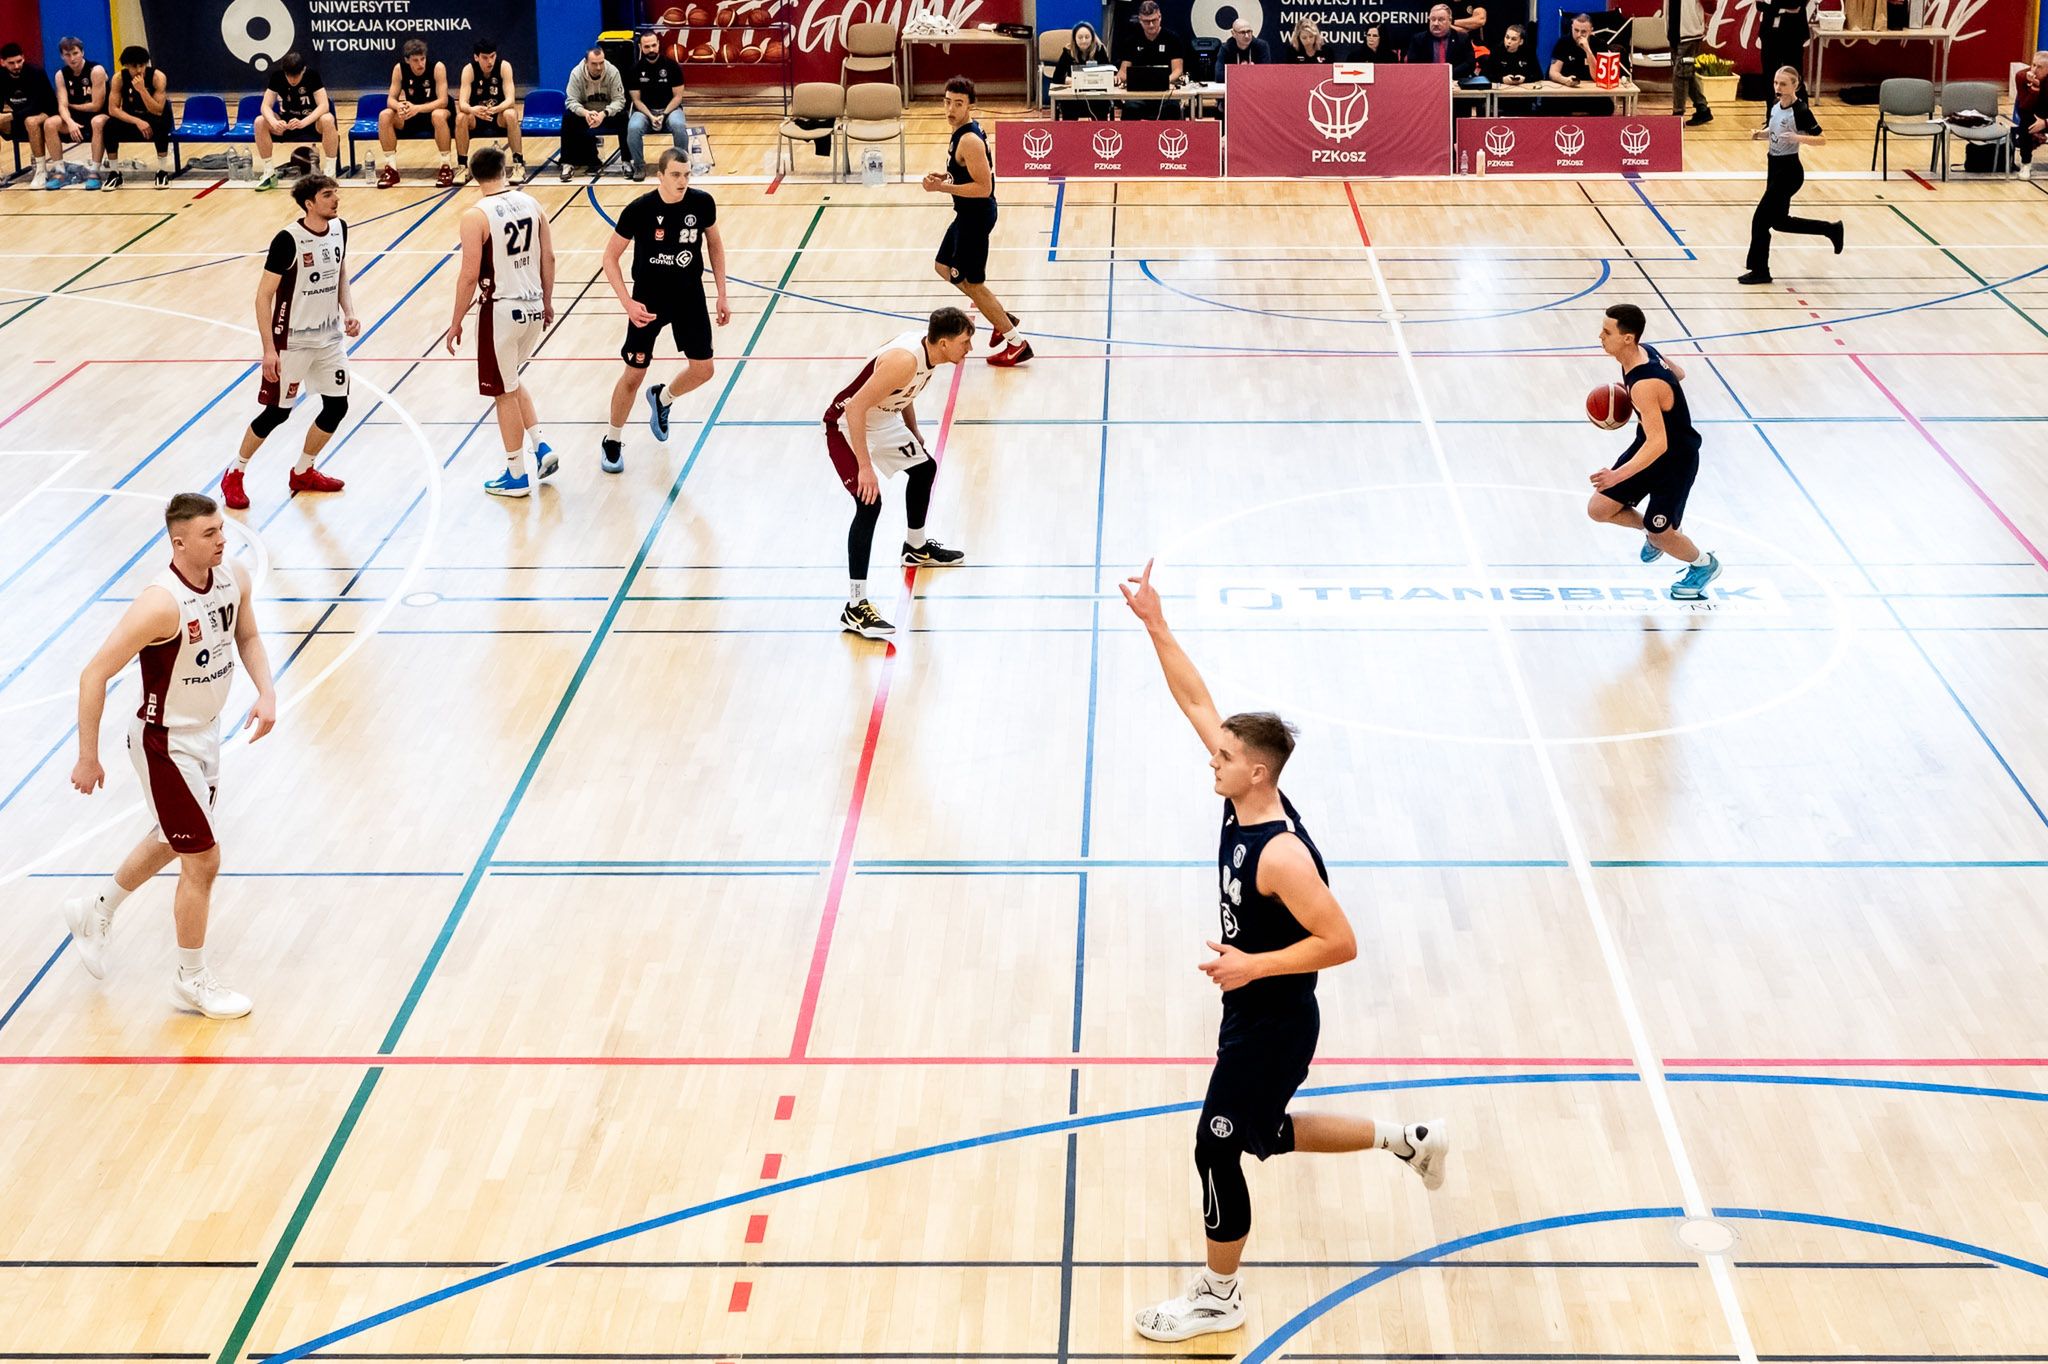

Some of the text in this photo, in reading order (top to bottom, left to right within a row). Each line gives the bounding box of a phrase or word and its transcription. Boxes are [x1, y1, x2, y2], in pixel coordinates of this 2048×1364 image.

[309, 1, 410, 14] UNIWERSYTET
[311, 18, 472, 32] MIKOŁAJA KOPERNIKA
[1280, 11, 1356, 24] MIKOŁAJA
[312, 38, 396, 52] W TORUNIU
[504, 217, 533, 256] 27
[678, 228, 698, 243] 25
[334, 246, 341, 264] 9
[334, 369, 346, 386] 9
[898, 441, 917, 458] 17
[181, 660, 235, 686] TRANSBR
